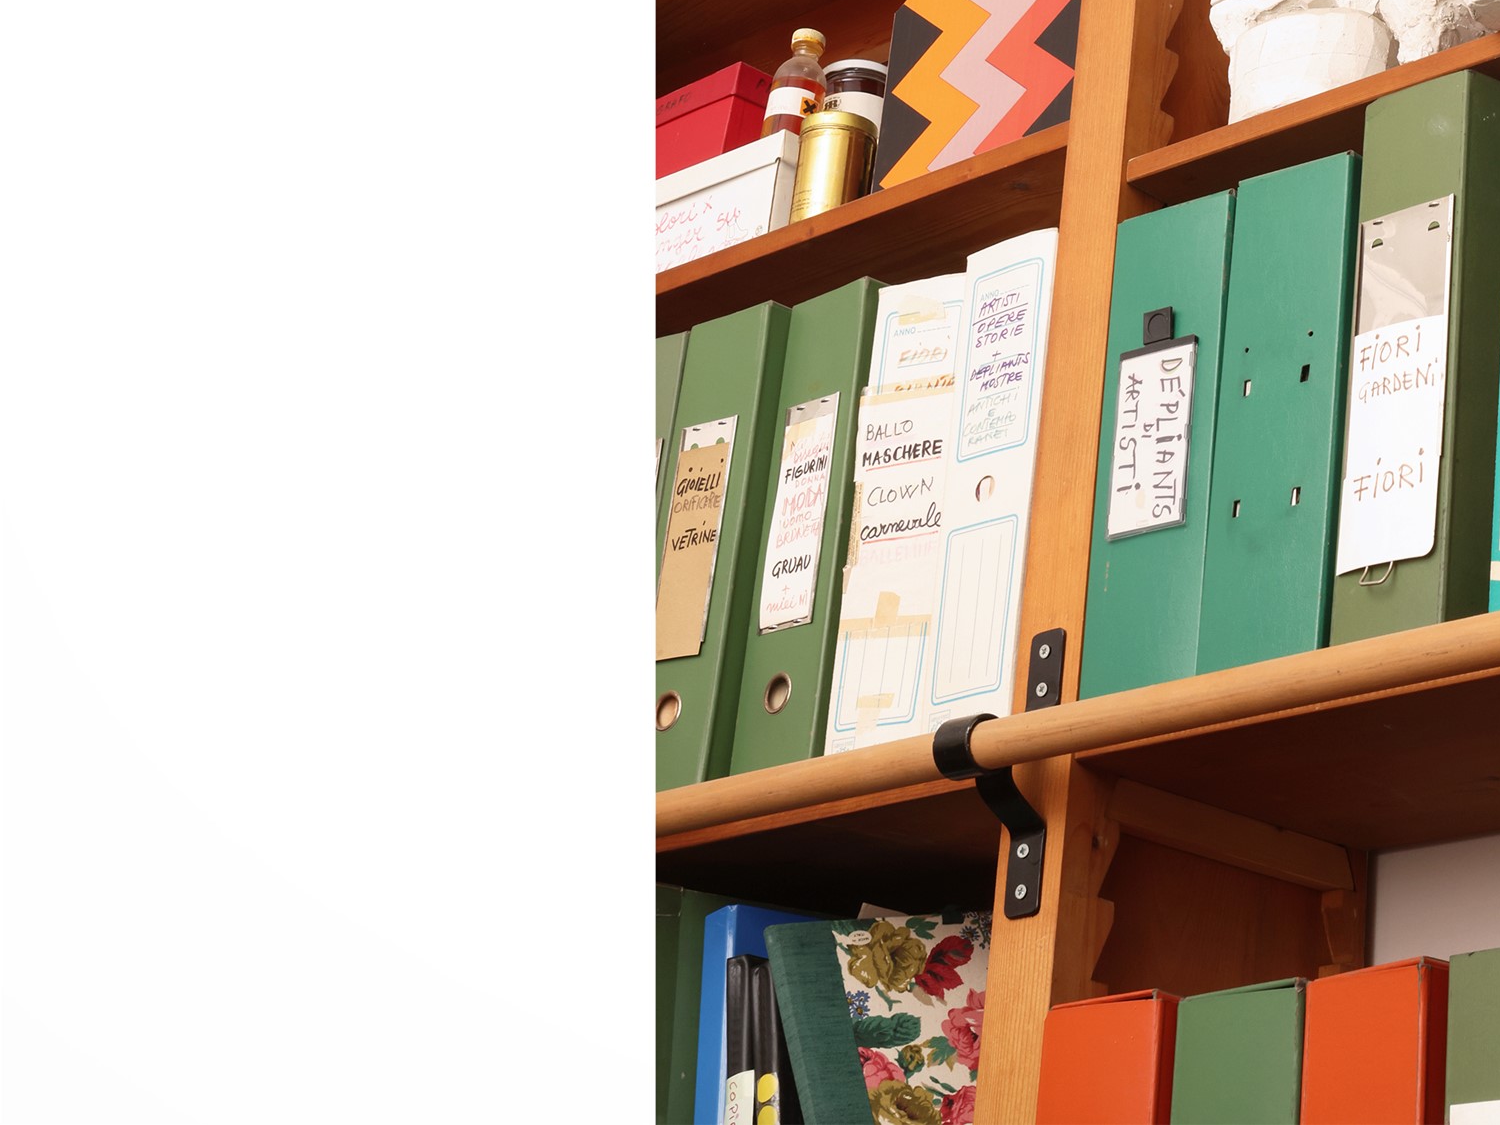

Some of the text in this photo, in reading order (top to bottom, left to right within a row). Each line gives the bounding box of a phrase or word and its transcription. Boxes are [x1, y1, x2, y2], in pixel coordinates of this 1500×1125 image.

[975, 324, 1025, 349] STORIE
[1360, 325, 1422, 372] FIORI
[866, 419, 914, 442] BALLO
[1116, 373, 1143, 493] ARTISTI
[862, 439, 943, 468] MASCHERE
[677, 465, 721, 497] GIOIELLI
[1353, 448, 1426, 502] FIORI
[867, 476, 934, 506] CLOWN
[672, 526, 717, 552] VETRINE
[772, 555, 811, 578] GRUAU
